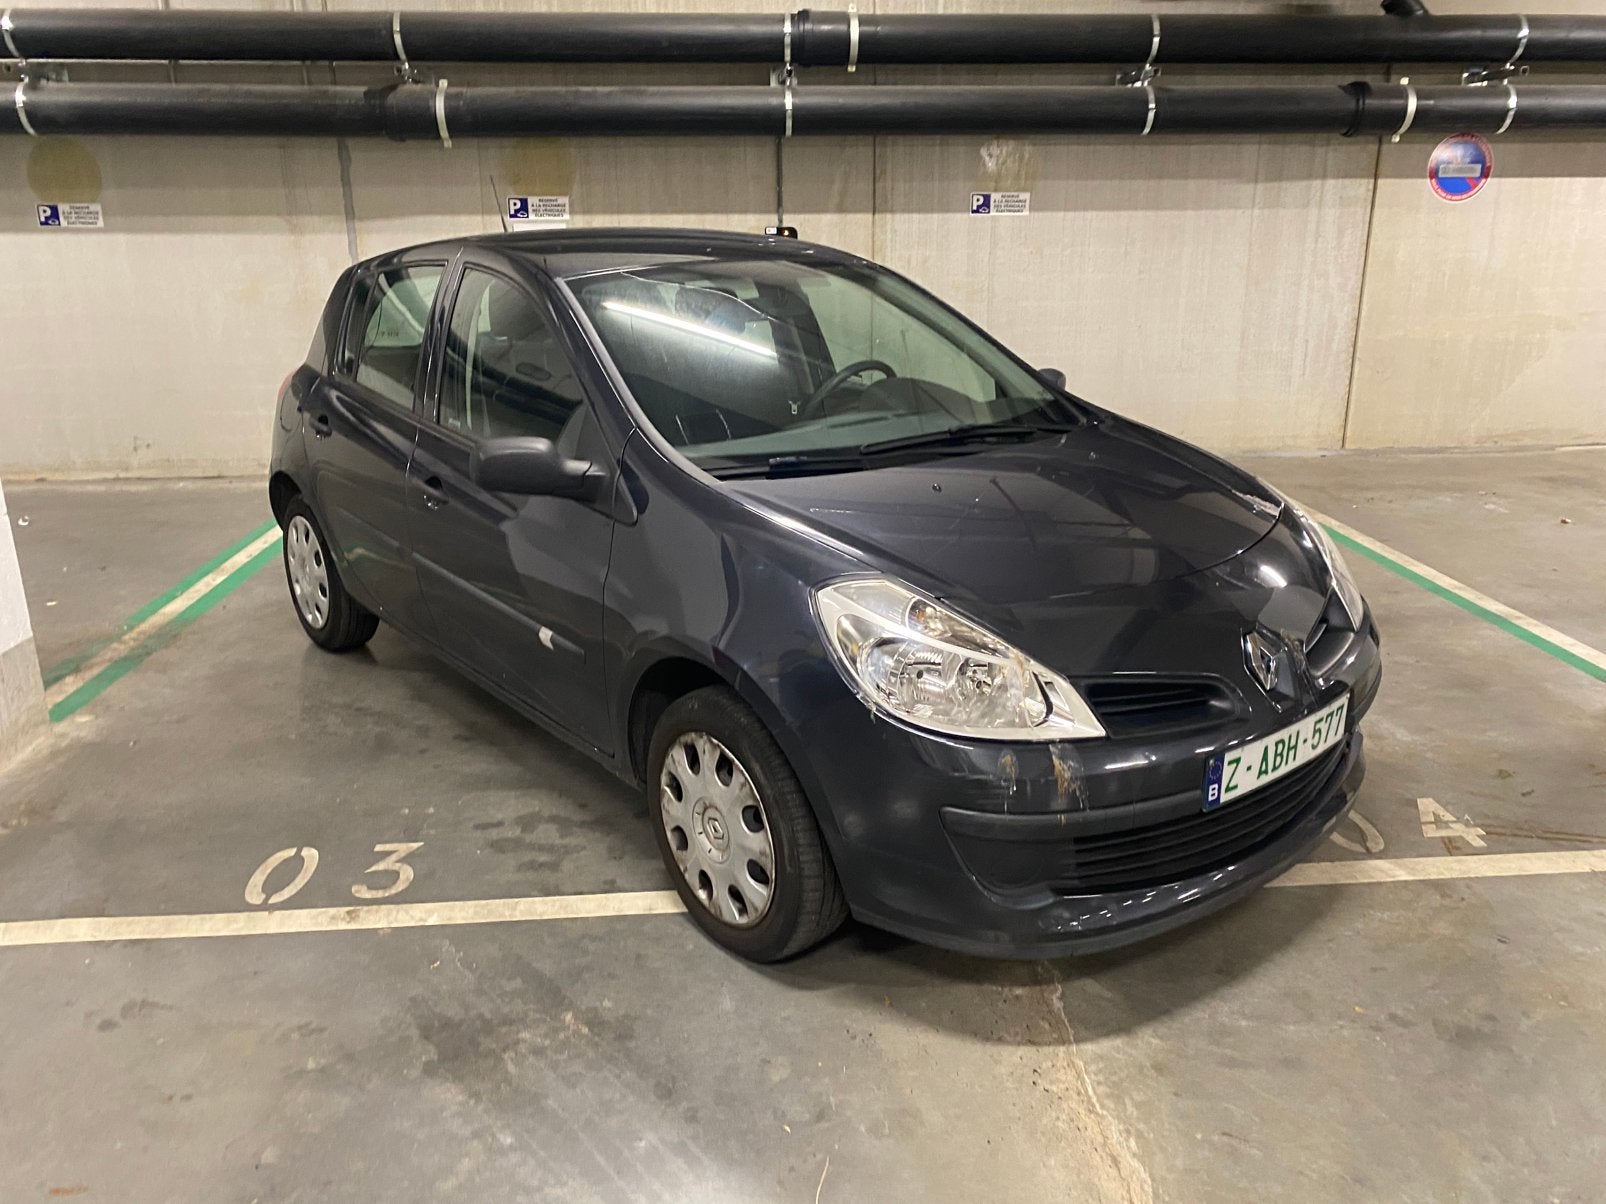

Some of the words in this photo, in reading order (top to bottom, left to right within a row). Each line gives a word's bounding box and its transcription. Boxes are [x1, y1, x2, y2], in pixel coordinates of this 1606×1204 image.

[508, 199, 520, 214] P
[972, 194, 984, 210] P
[38, 206, 51, 222] P
[1208, 784, 1218, 802] B
